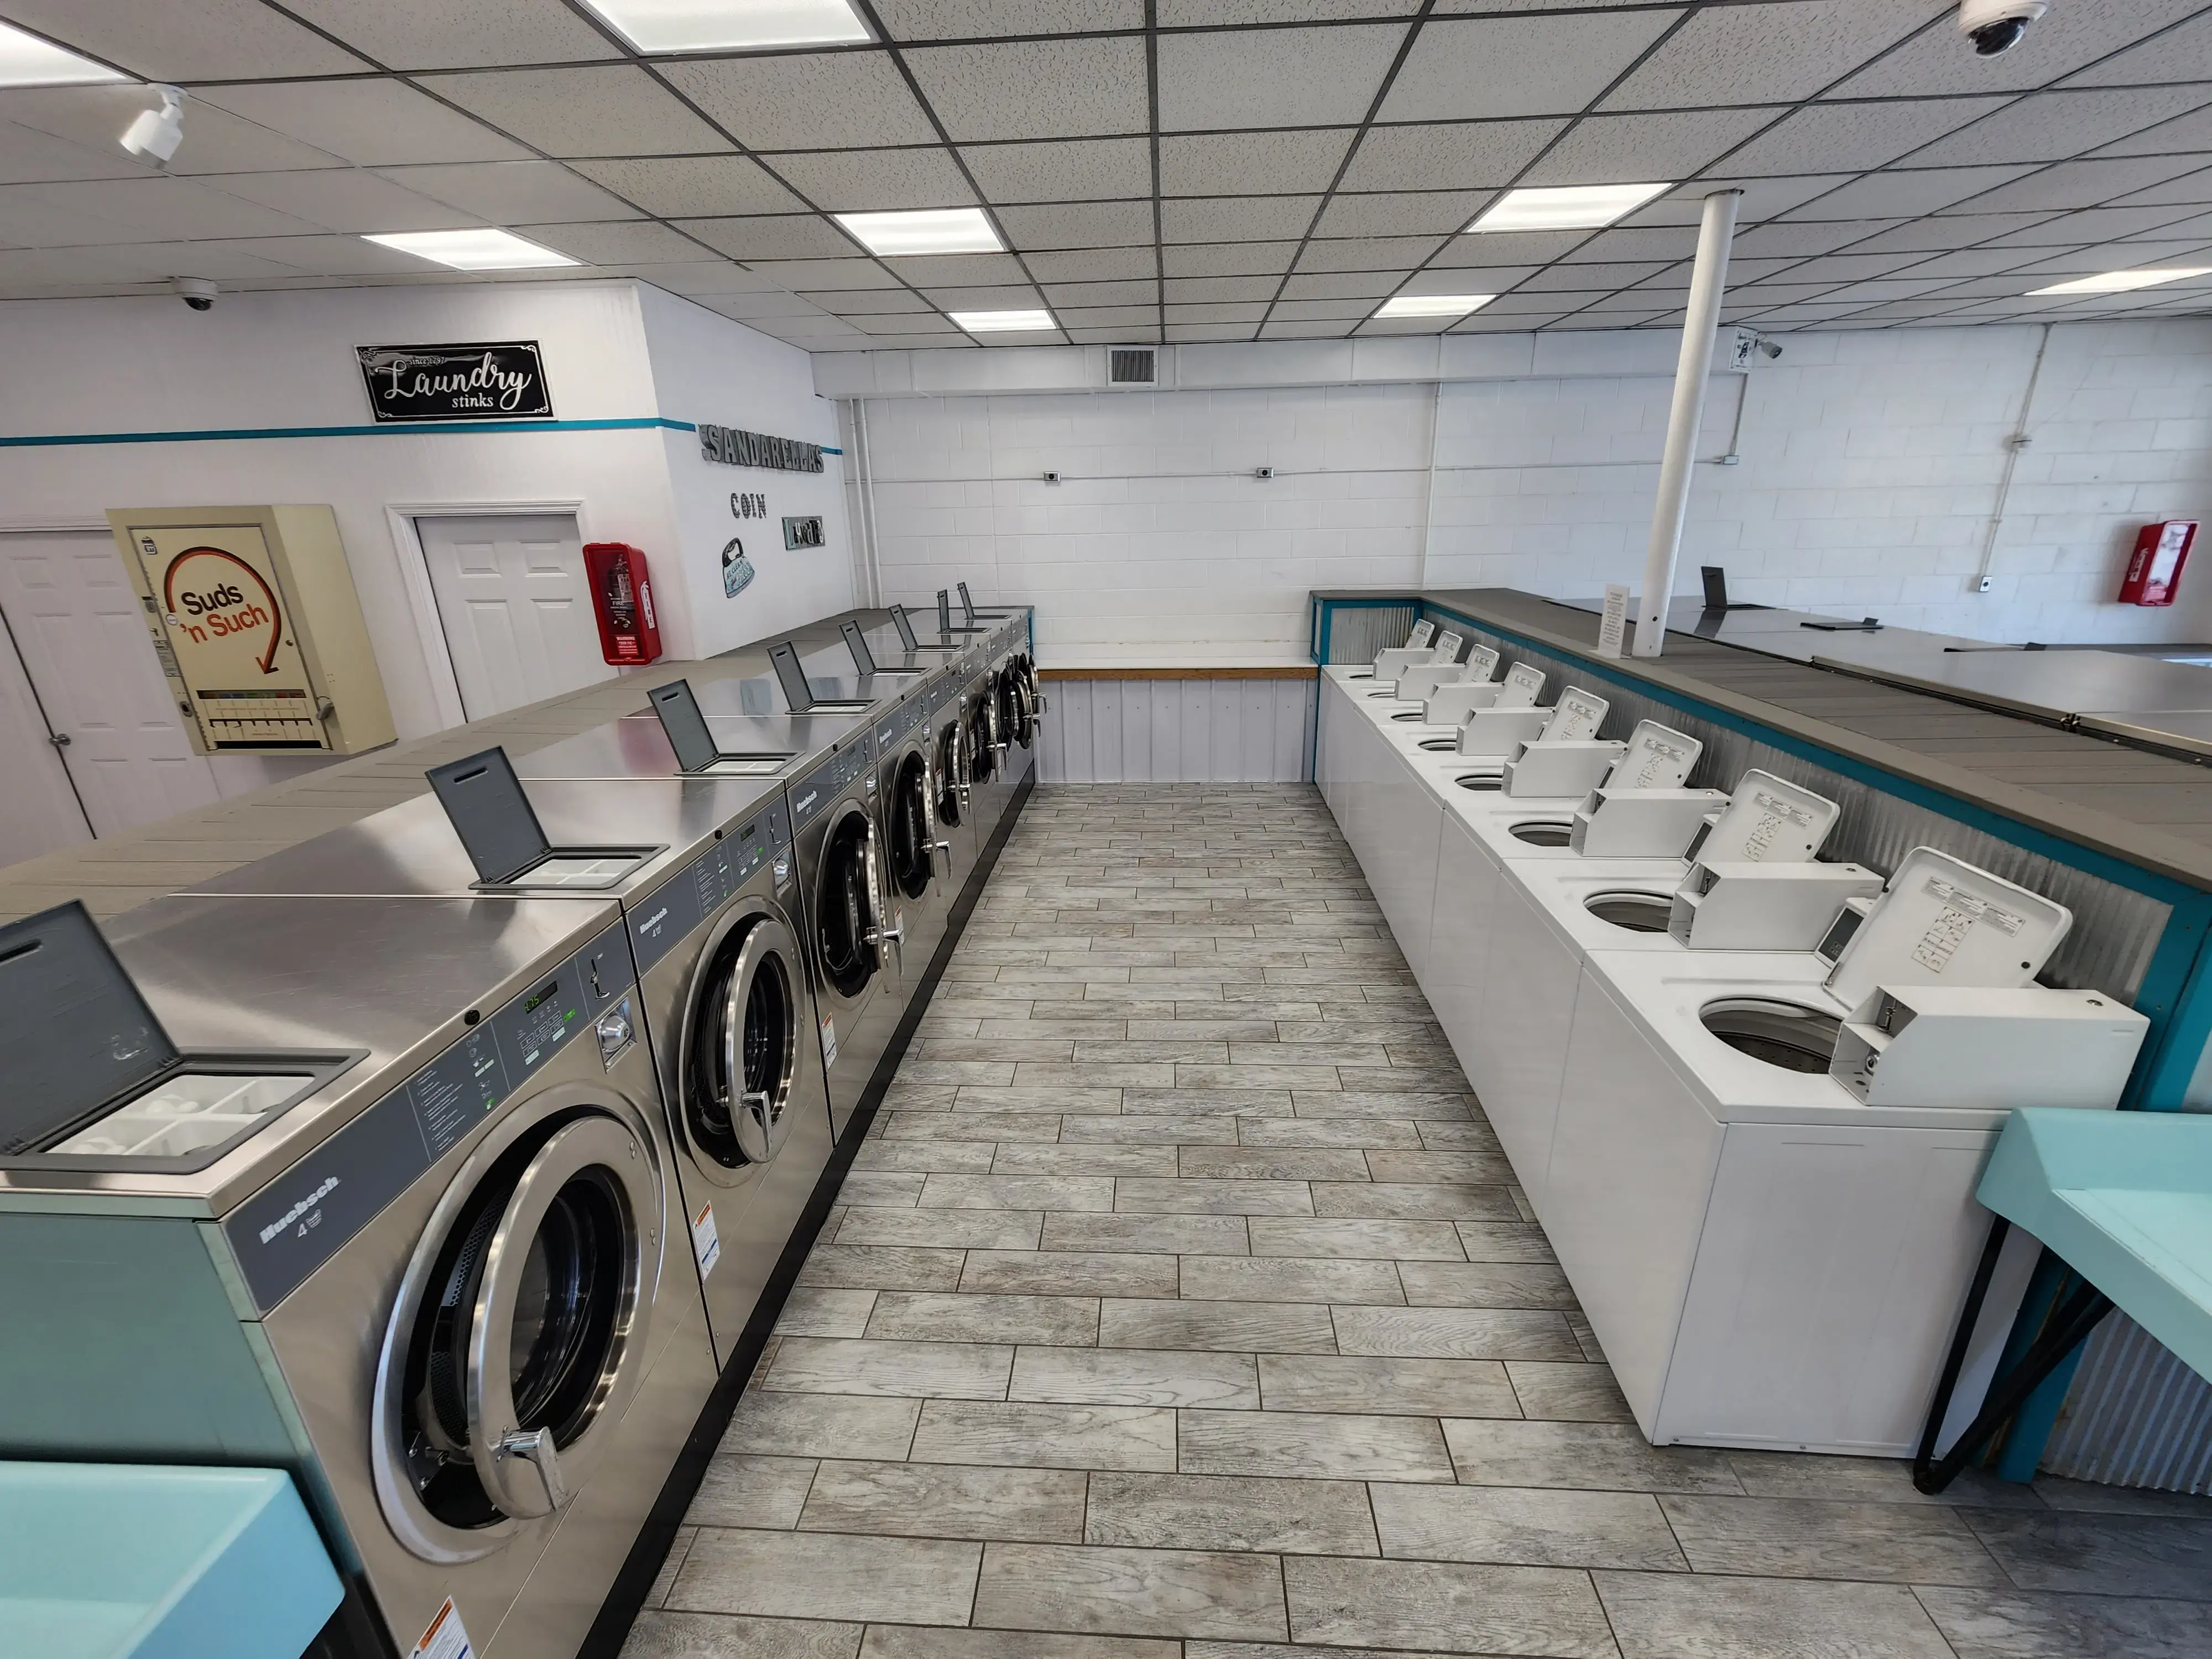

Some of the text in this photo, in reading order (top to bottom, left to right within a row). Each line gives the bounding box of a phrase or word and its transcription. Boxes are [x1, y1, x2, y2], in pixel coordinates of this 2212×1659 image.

[375, 352, 532, 410] Laundry
[452, 393, 494, 408] stinks
[699, 424, 824, 473] SANDARELLAS
[731, 493, 766, 519] COIN
[181, 583, 243, 615] Suds
[180, 623, 208, 643] 'n
[207, 603, 269, 637] Such
[259, 1176, 339, 1244] Huebsch
[298, 1223, 308, 1238] 4
